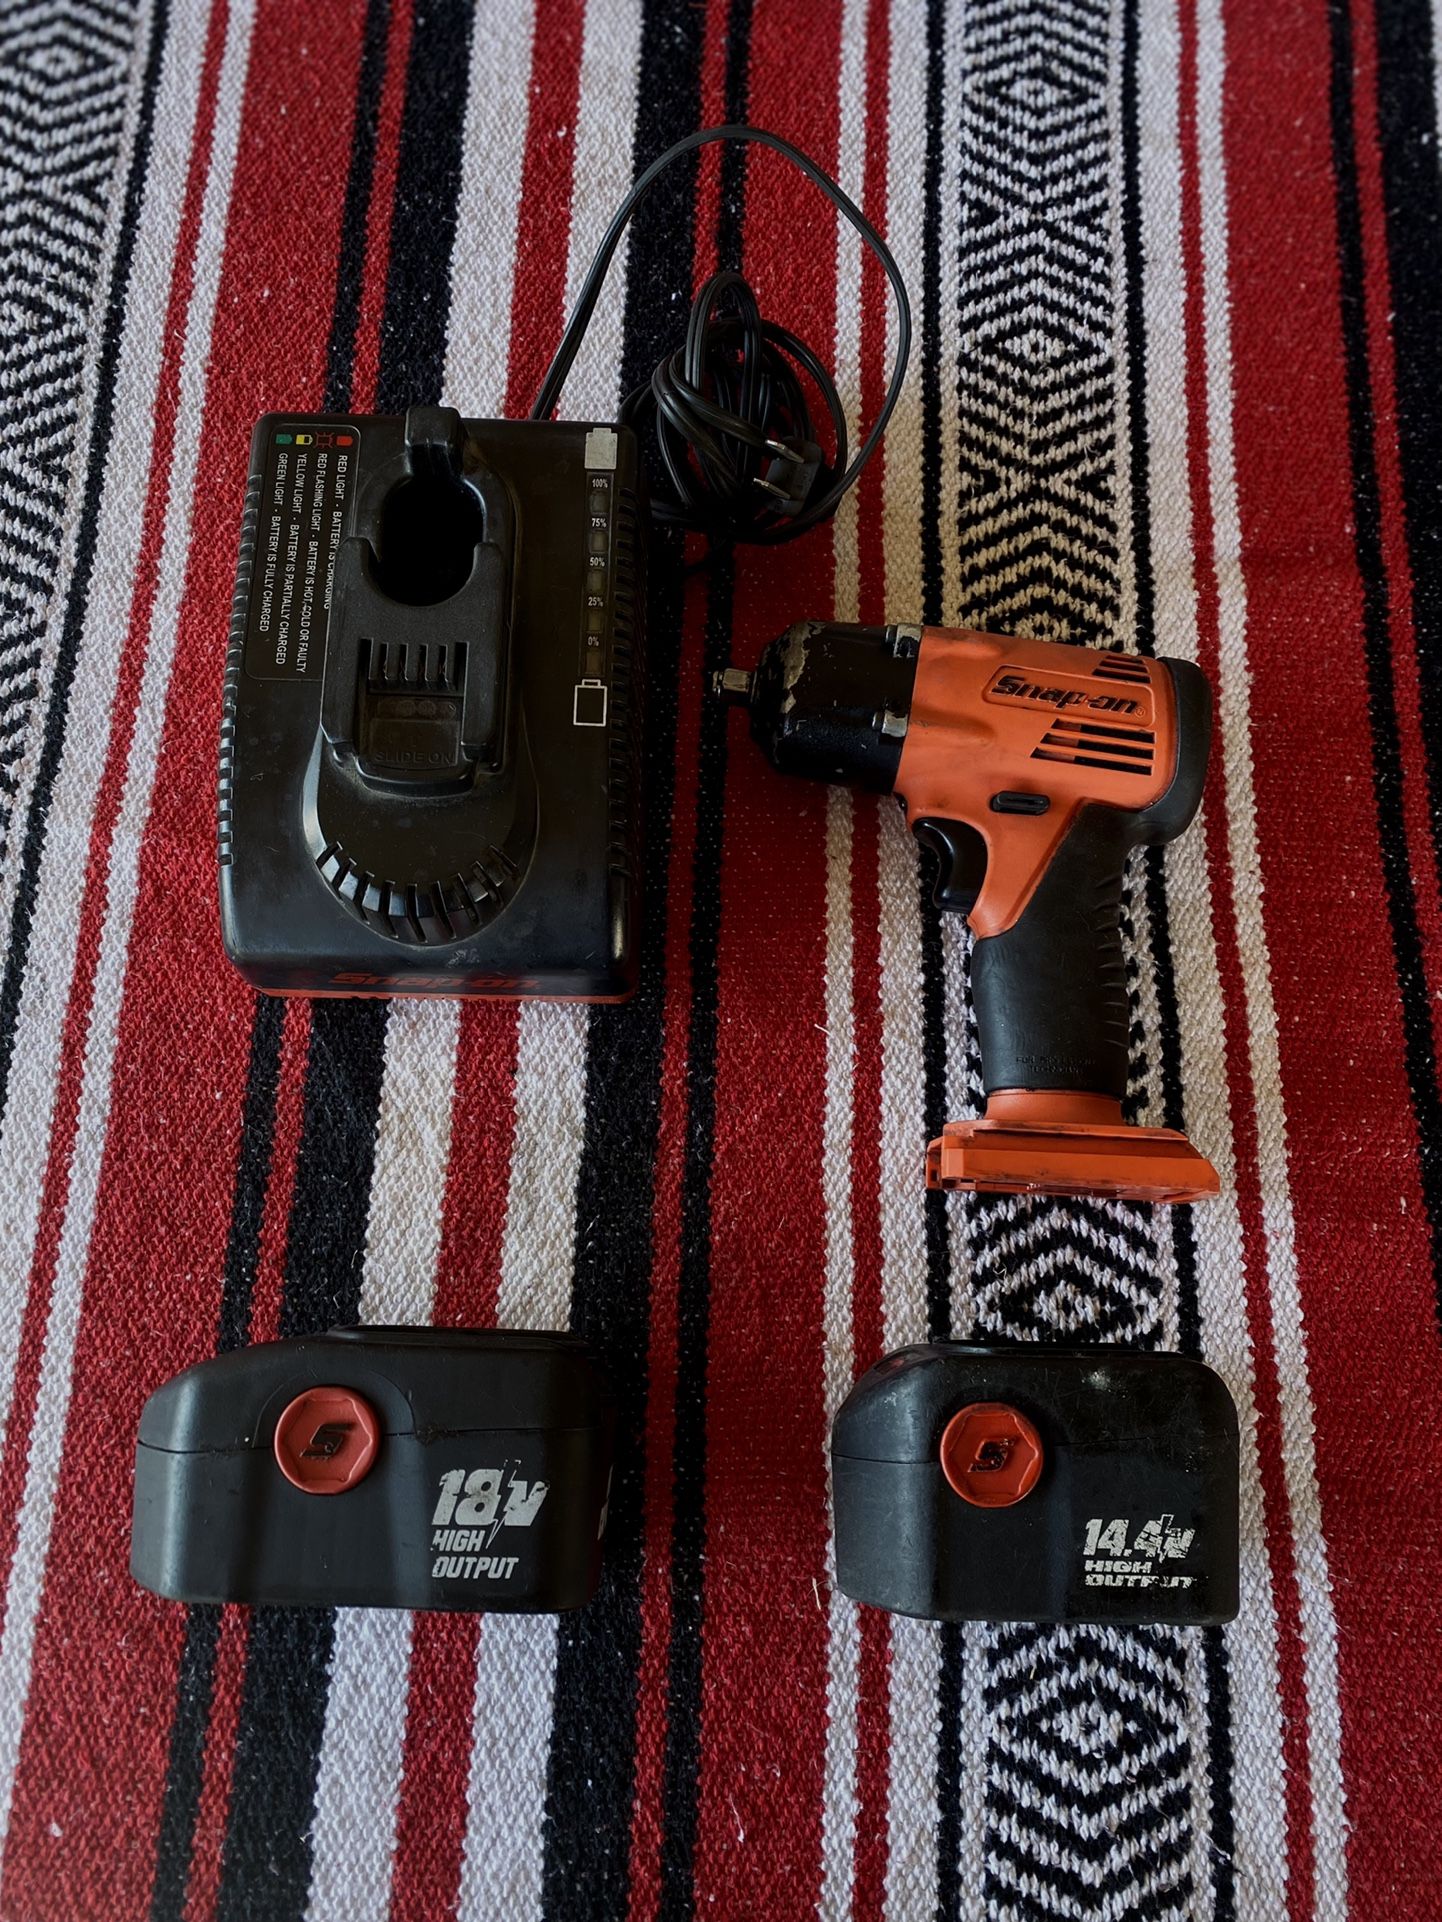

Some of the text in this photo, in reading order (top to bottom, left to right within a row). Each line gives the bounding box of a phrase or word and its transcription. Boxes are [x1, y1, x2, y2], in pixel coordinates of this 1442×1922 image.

[277, 452, 288, 480] GREEN
[295, 453, 308, 488] YELLOW
[317, 453, 328, 469] RED
[337, 454, 348, 472] RED
[274, 482, 285, 506] LIGHT
[313, 470, 326, 508] FLASHING
[334, 474, 346, 500] LIGHT
[592, 478, 608, 488] 100%
[292, 489, 303, 514] LIGHT
[311, 509, 322, 531] LIGHT
[330, 511, 342, 551] BATTERY
[591, 518, 607, 527] 75%
[268, 516, 281, 552] BATTERY
[287, 524, 299, 562] BATTERY
[267, 554, 277, 562] IS
[306, 541, 318, 576] BATTERY
[328, 552, 336, 560] IS
[589, 557, 605, 567] 50%
[264, 564, 276, 589] FULLY
[285, 564, 295, 572] IS
[281, 574, 294, 619] PARTIALLY
[588, 596, 604, 607] 25%
[260, 590, 273, 631] CHARGED
[300, 605, 312, 628] COLD
[276, 621, 289, 665] CHARGED
[299, 629, 310, 641] OR
[588, 636, 600, 646] 0%
[296, 642, 308, 673] FAULTY
[374, 752, 456, 766] SLIDE ON
[432, 1530, 486, 1552] HIGH
[432, 1556, 520, 1580] OUTPUT
[1084, 1560, 1152, 1574] HIGH
